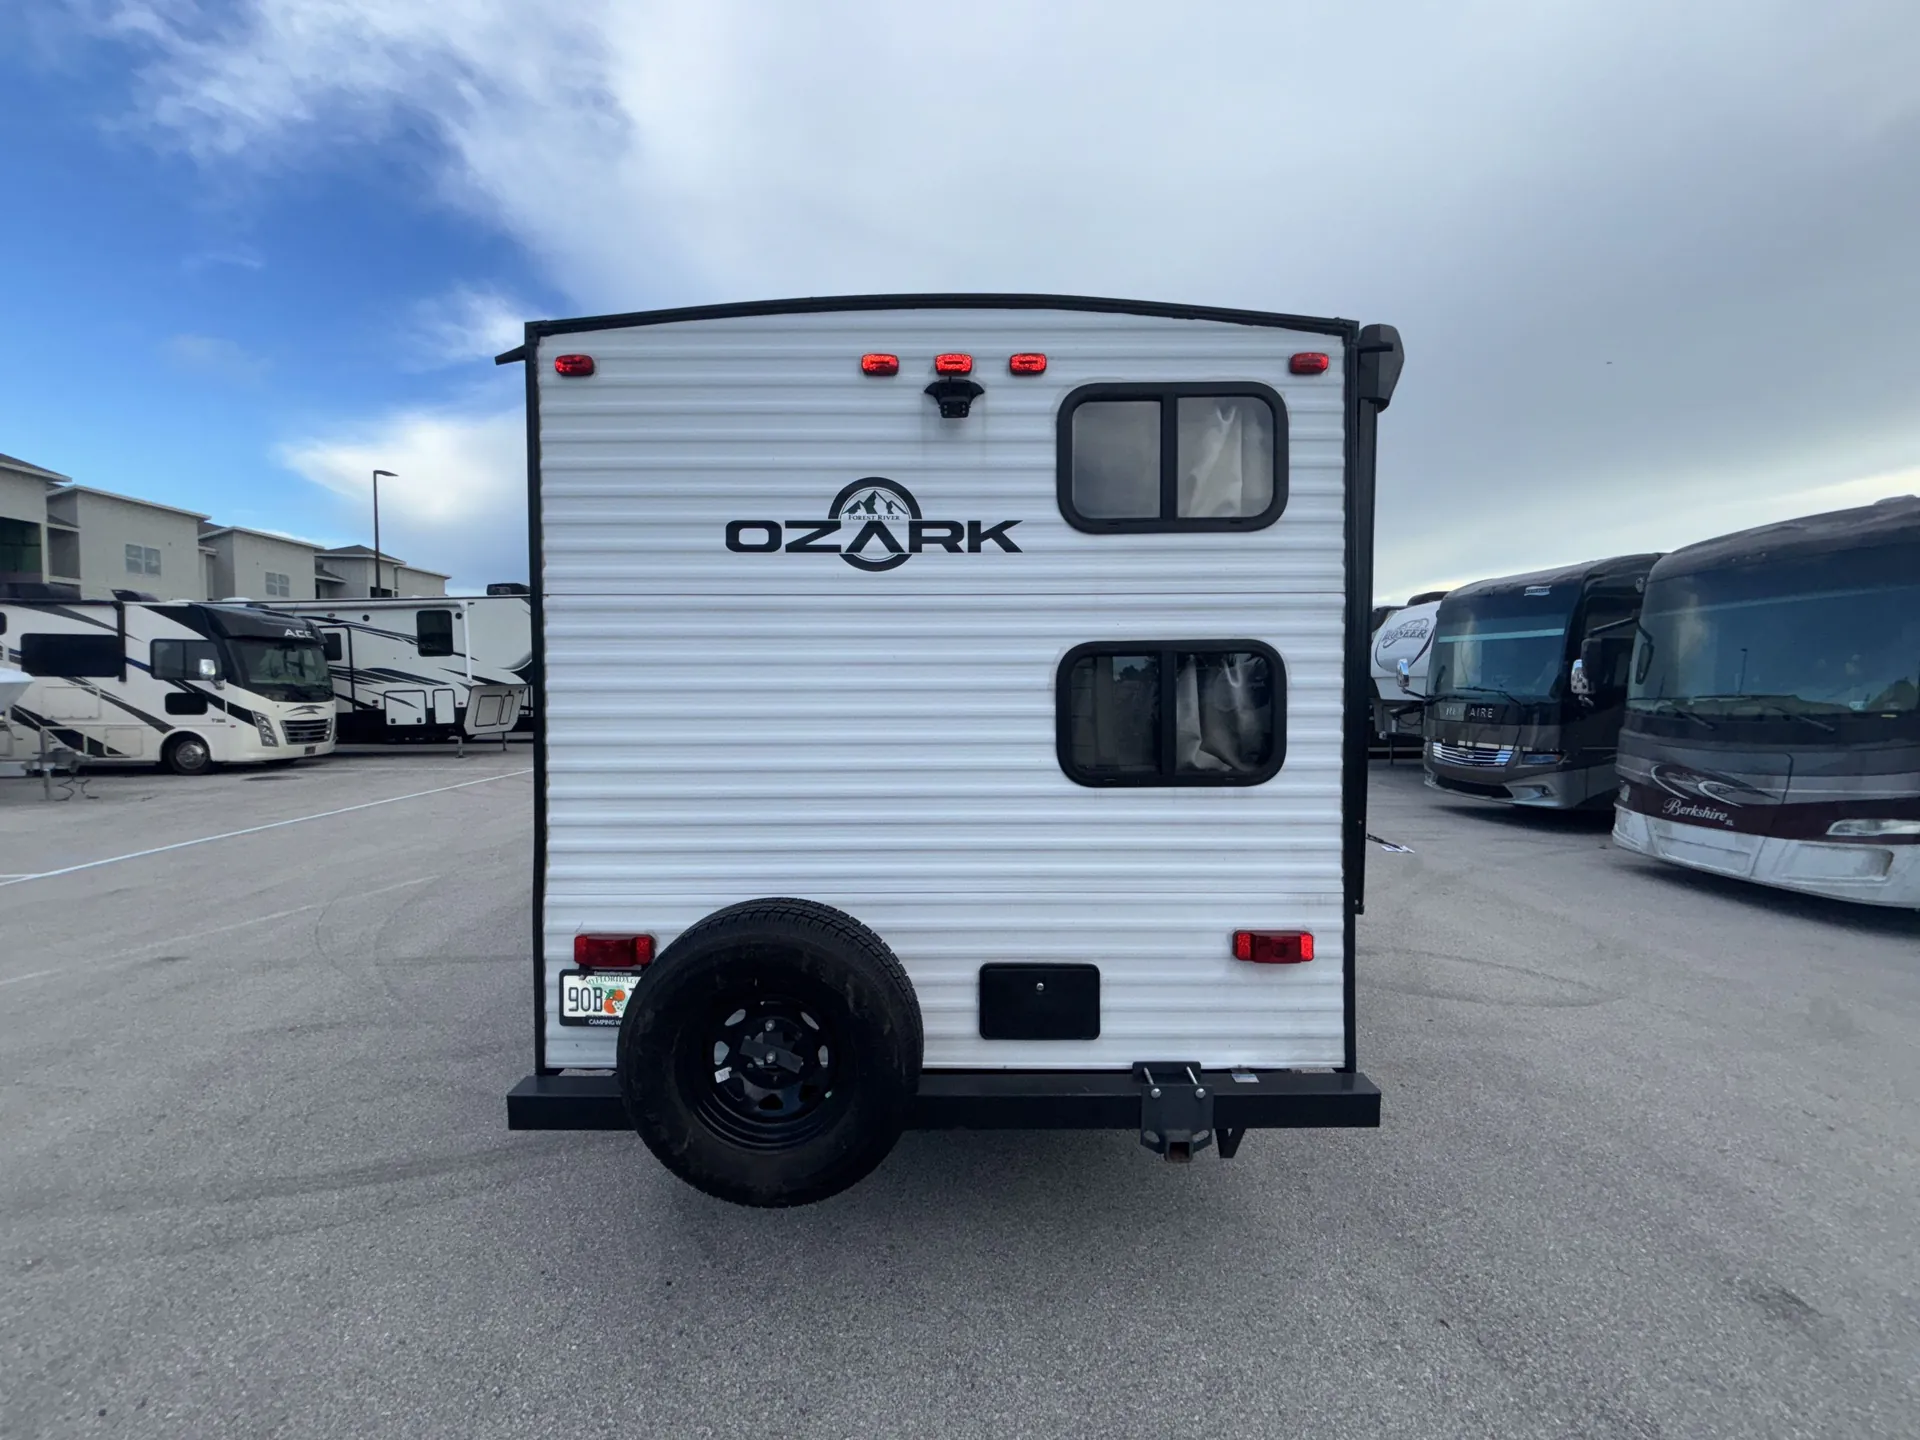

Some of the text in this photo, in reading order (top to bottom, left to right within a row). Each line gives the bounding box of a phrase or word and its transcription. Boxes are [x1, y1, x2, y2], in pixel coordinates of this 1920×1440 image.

[725, 520, 1024, 553] OZARK
[284, 628, 315, 639] ACE
[1469, 707, 1494, 718] AIRE
[1662, 797, 1728, 821] Berkshire
[568, 986, 603, 1012] 90B
